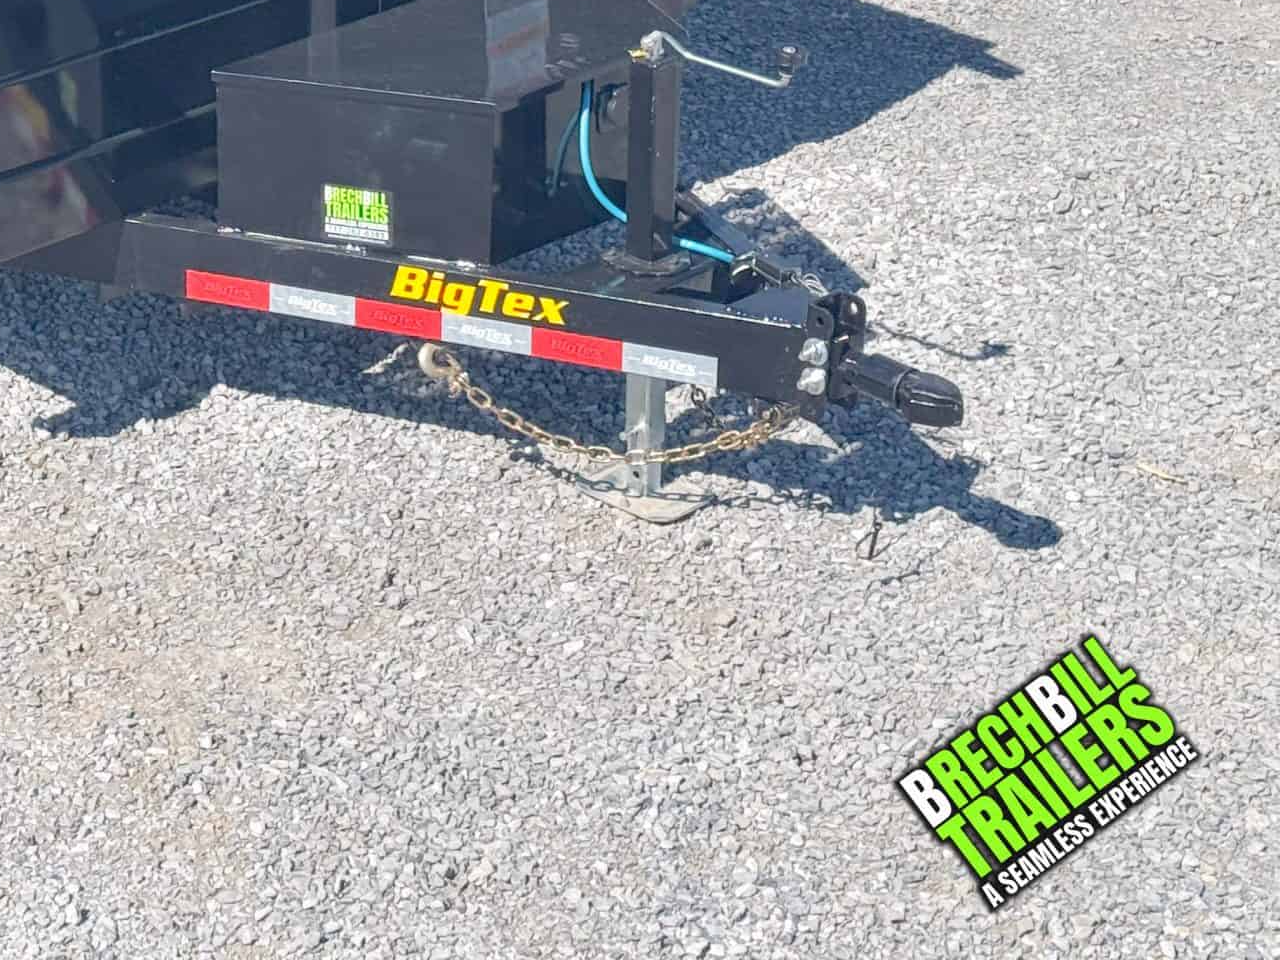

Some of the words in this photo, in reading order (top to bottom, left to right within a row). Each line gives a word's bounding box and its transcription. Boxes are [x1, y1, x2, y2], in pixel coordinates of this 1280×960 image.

[325, 202, 389, 225] TRAILERS
[390, 265, 570, 326] BigTex
[459, 324, 513, 345] BigTex
[642, 353, 696, 375] BigTex
